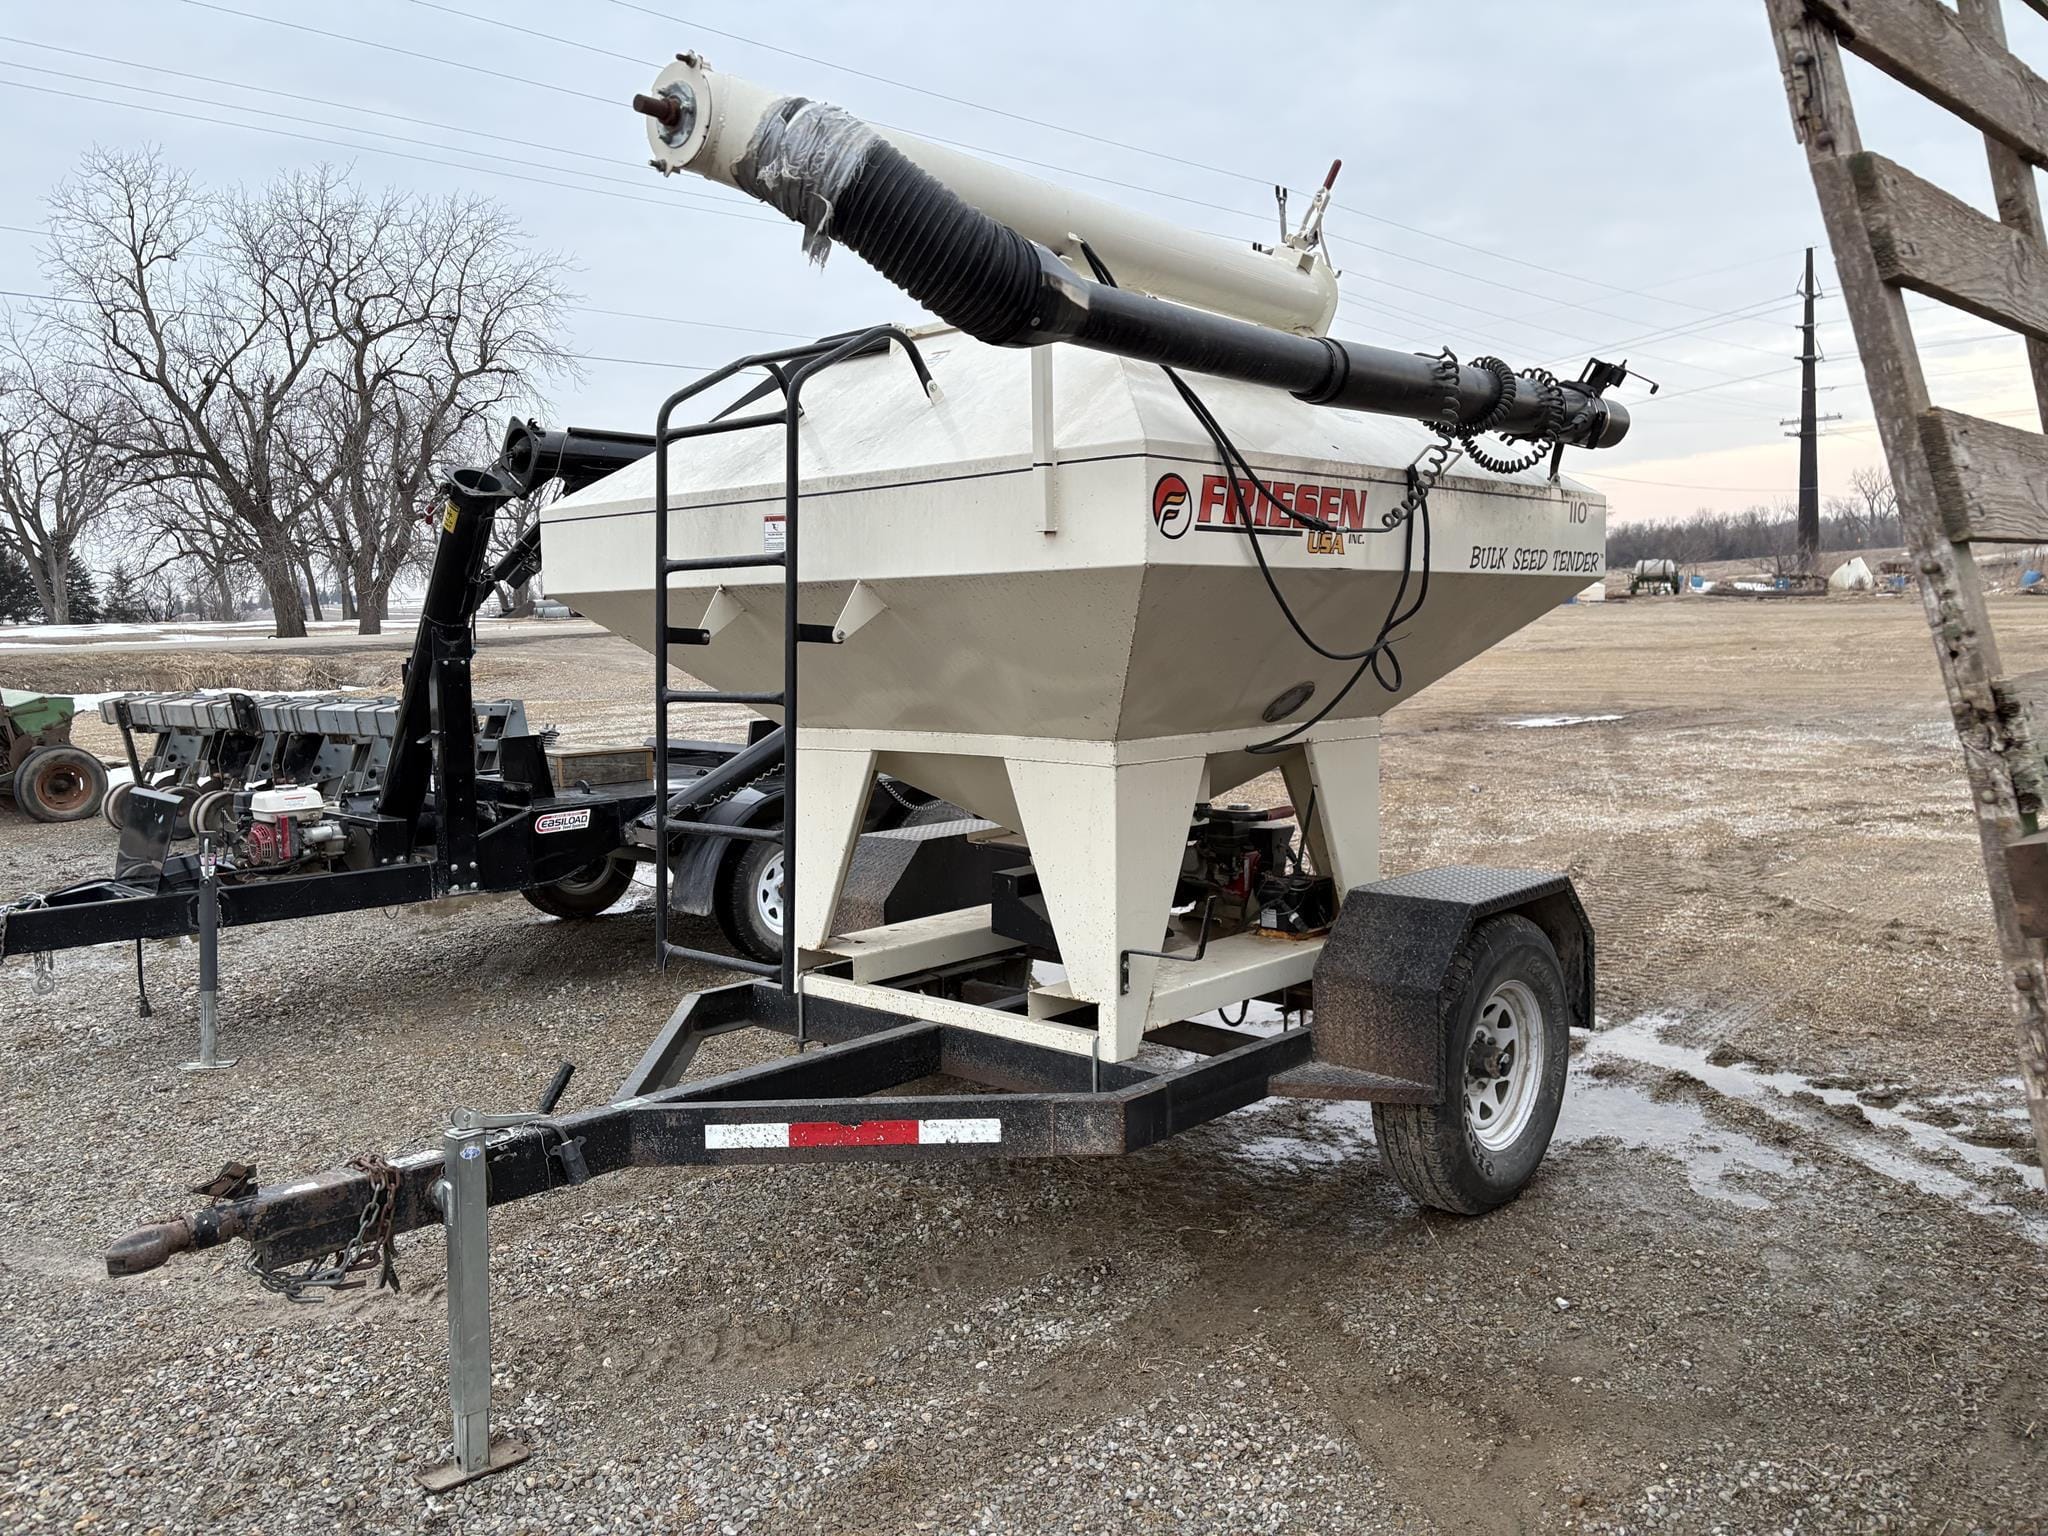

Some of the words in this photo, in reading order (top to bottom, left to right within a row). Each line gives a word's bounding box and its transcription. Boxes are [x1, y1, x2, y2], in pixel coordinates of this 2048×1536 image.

[1198, 474, 1368, 530] FRIESEN
[1569, 501, 1588, 524] 110
[1306, 531, 1345, 555] USA
[1470, 546, 1509, 570] BULK
[1512, 548, 1548, 571] SEED
[1553, 550, 1600, 573] TENDER
